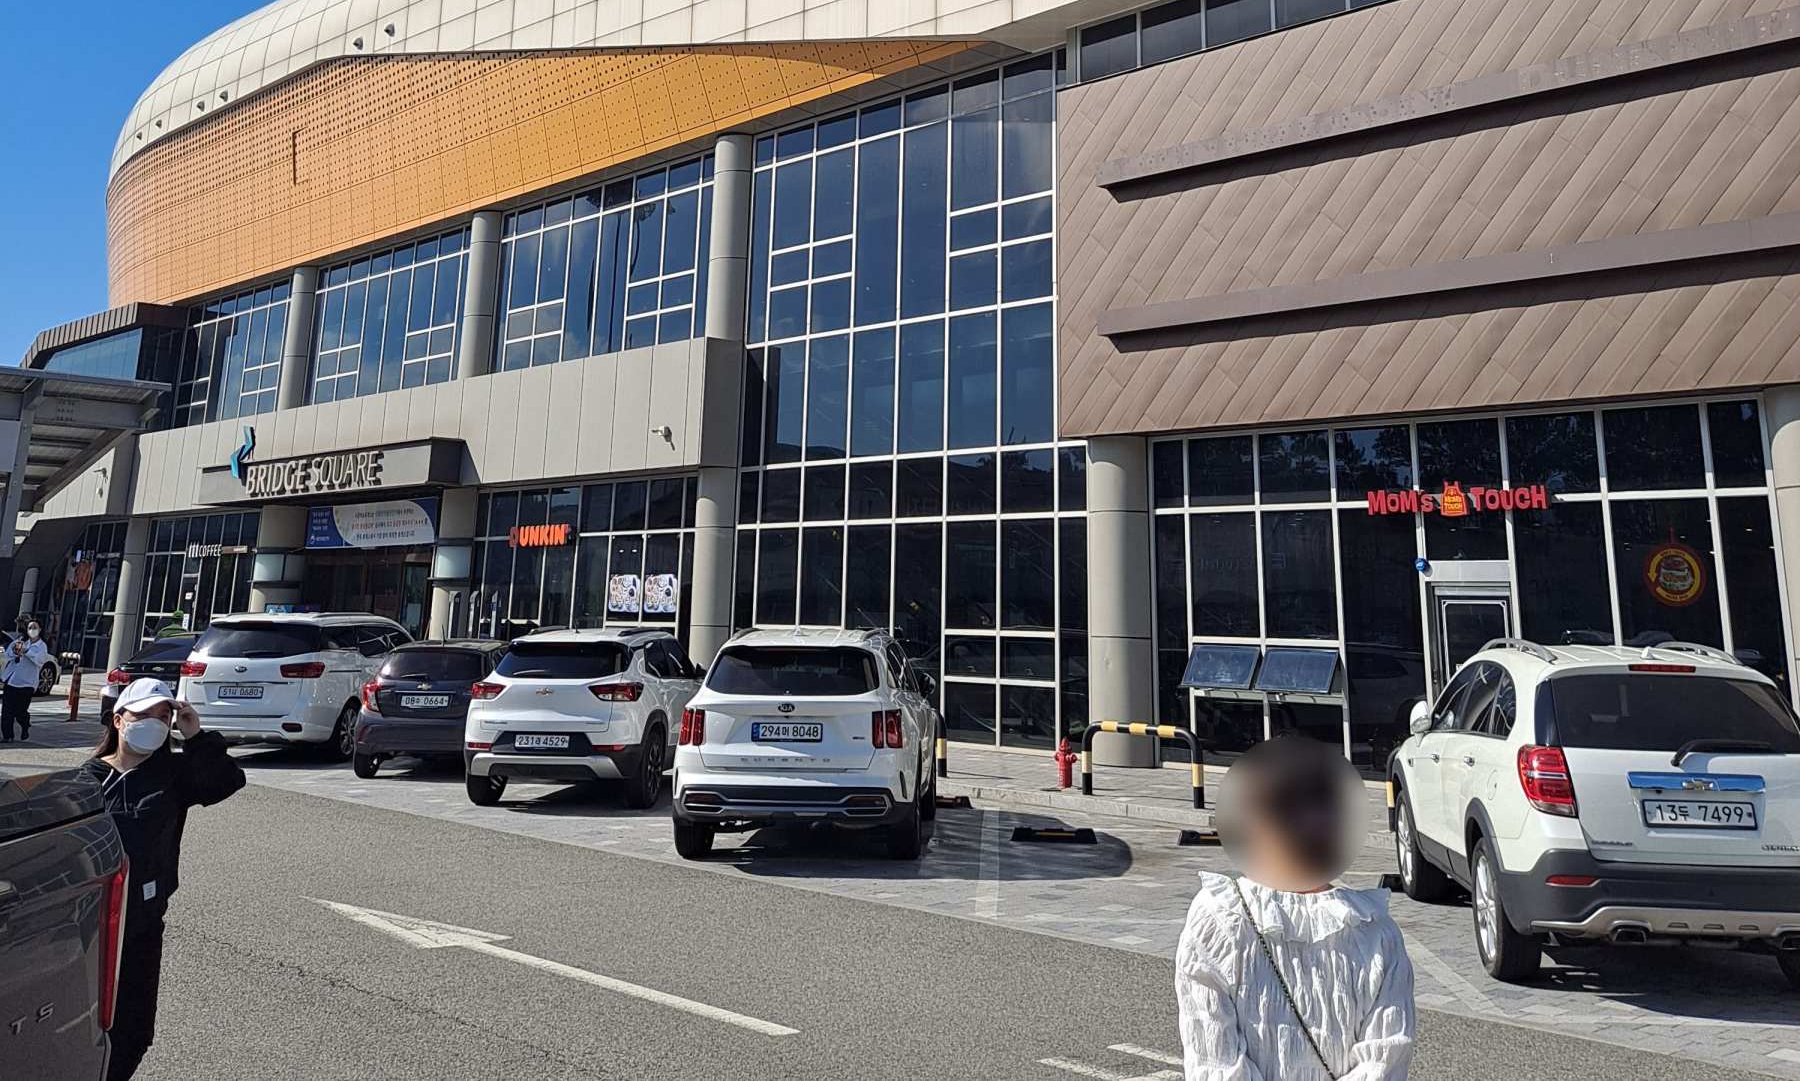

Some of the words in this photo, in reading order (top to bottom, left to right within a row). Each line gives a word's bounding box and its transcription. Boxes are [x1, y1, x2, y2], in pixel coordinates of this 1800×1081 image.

[245, 459, 307, 494] BRIDGE
[310, 450, 380, 487] SQUARE
[1470, 484, 1547, 512] TOUCH
[199, 543, 222, 557] COFFEE
[792, 725, 819, 738] 8048
[542, 736, 566, 747] 4529
[1655, 804, 1690, 822] 13두
[1697, 805, 1745, 824] 7499
